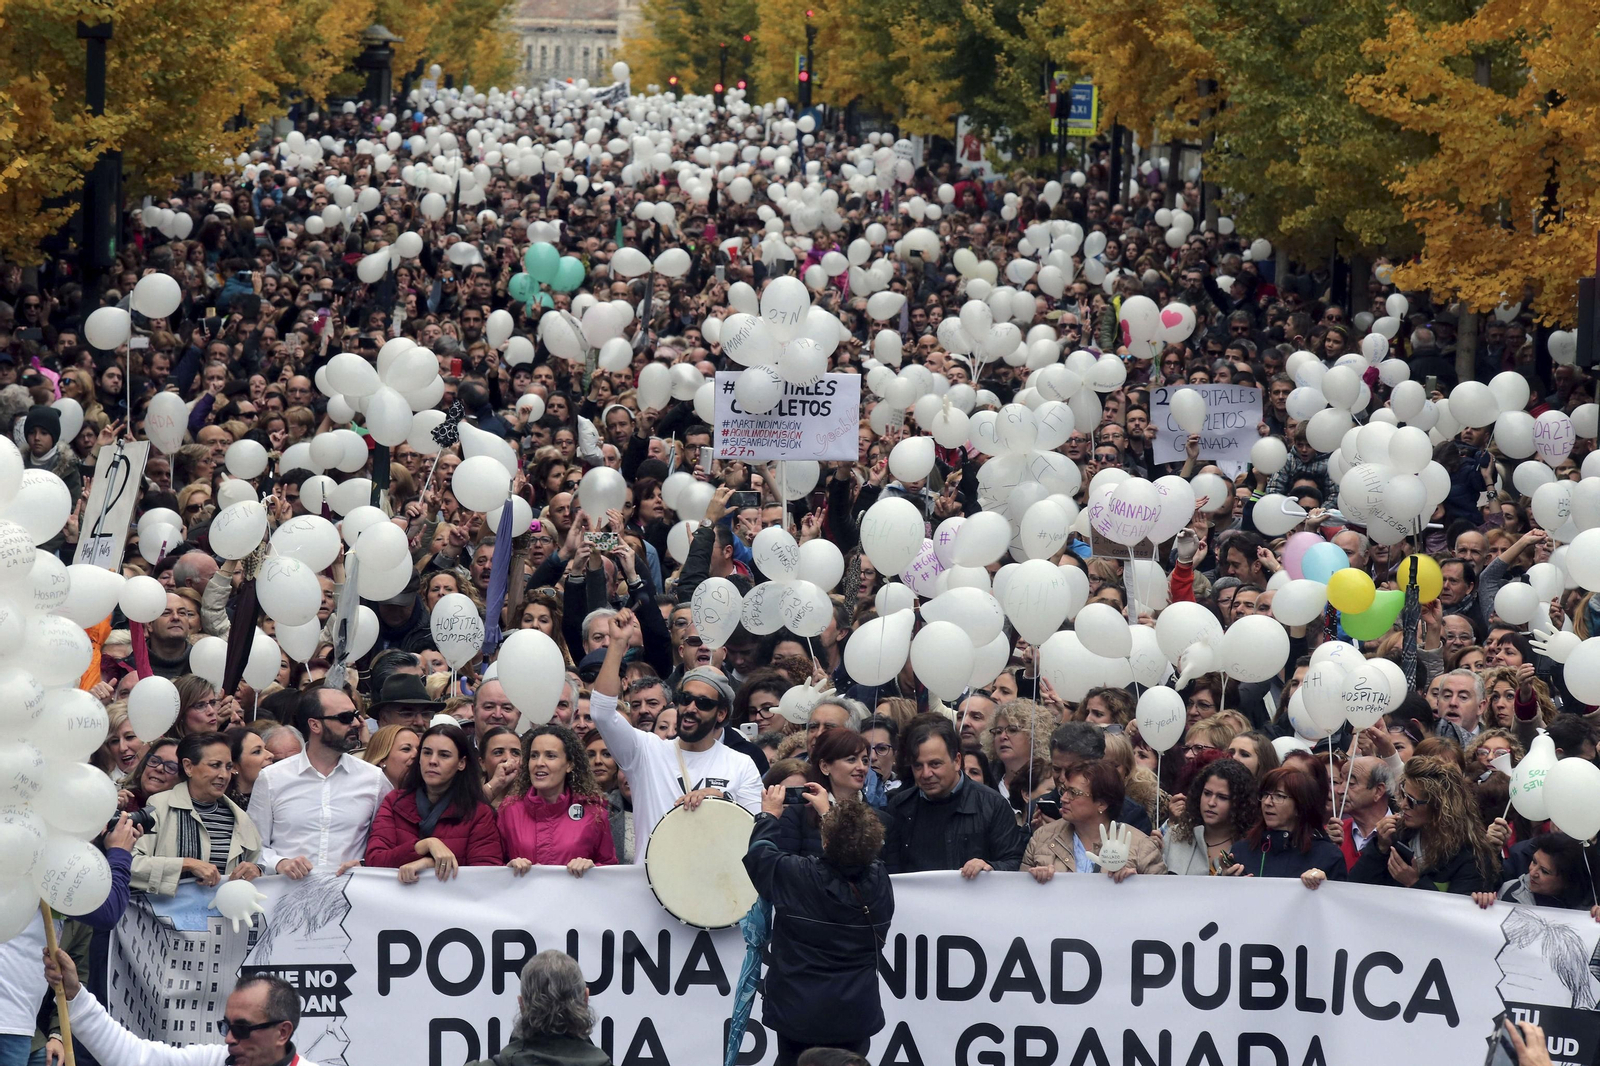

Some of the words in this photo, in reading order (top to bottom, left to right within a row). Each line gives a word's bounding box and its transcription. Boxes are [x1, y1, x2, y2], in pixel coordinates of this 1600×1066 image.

[1155, 387, 1170, 406] 2
[1173, 434, 1239, 453] GANADA
[90, 452, 131, 539] 2
[1353, 676, 1373, 691] 2
[304, 969, 338, 989] NO
[377, 928, 538, 996] POR
[1130, 921, 1461, 1028] PÚBLICA
